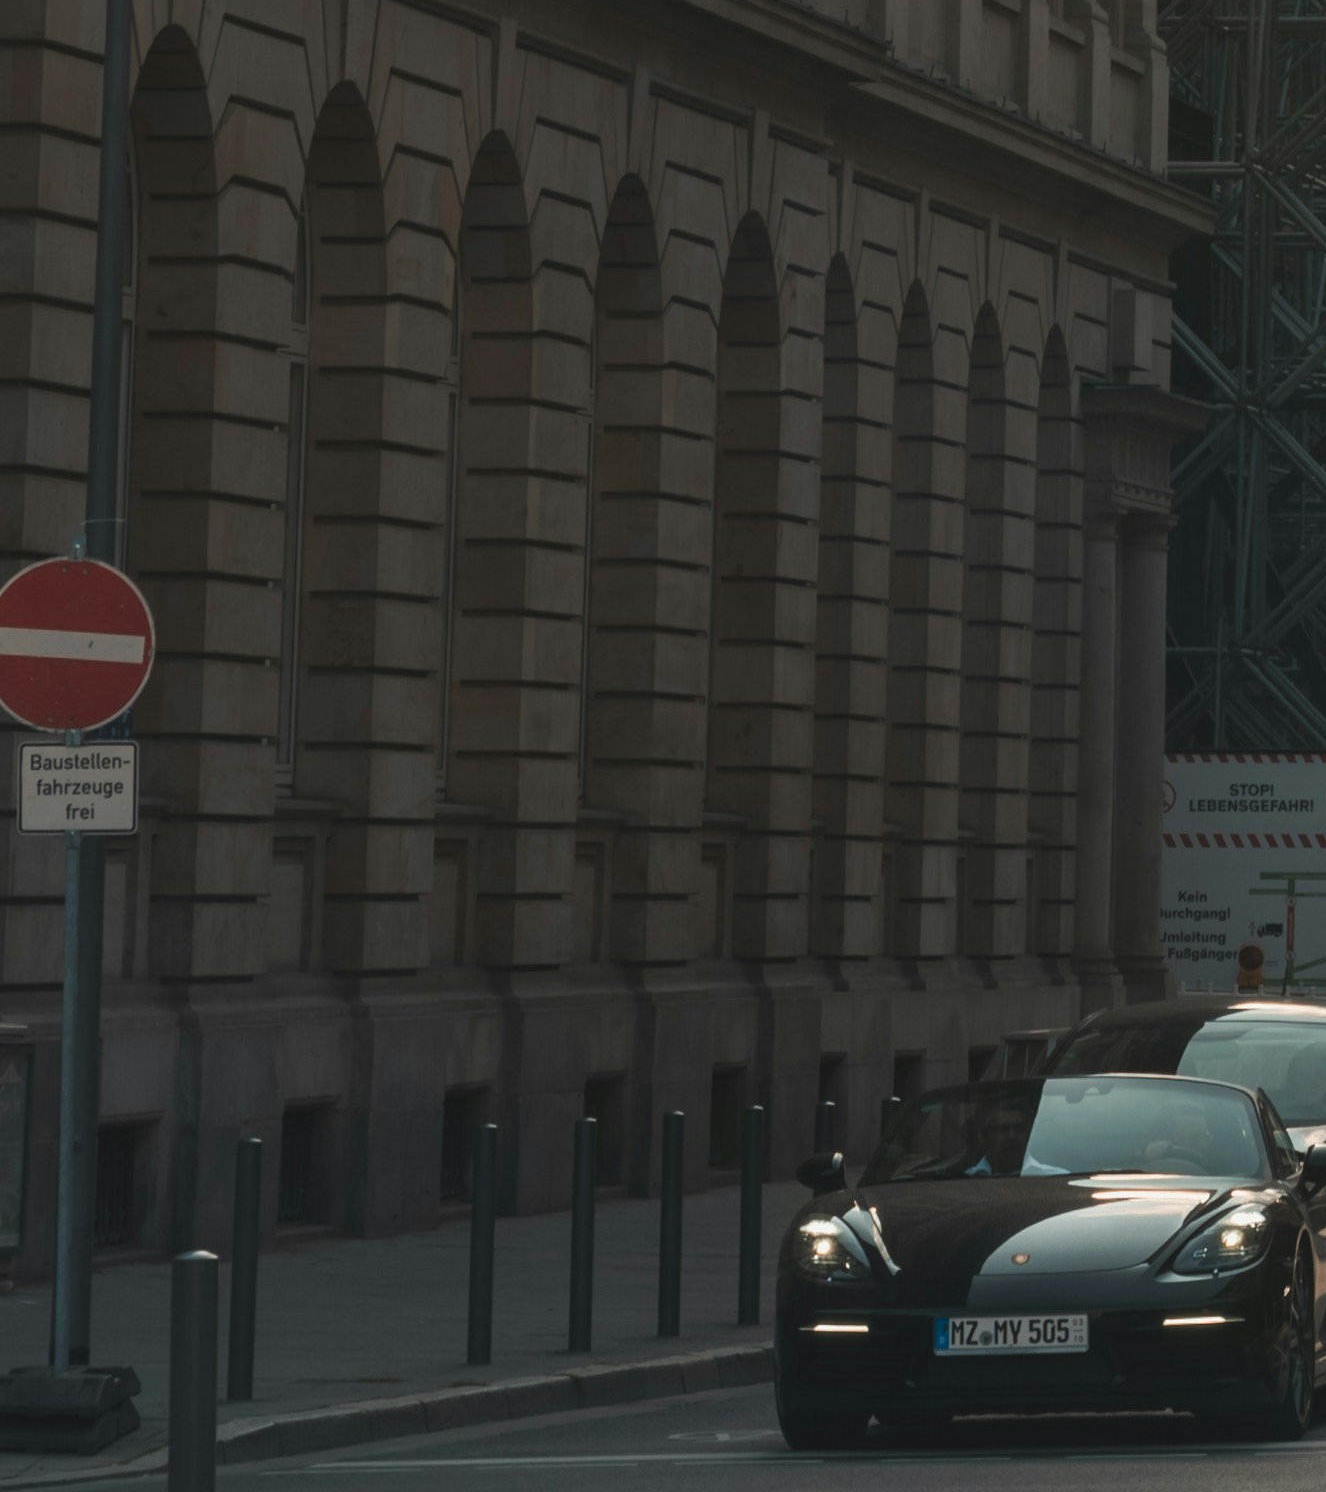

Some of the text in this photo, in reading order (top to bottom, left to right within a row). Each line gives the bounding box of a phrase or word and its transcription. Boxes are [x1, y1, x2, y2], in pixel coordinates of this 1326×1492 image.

[30, 753, 131, 771] Baustellen-
[36, 778, 125, 799] fahrzeuge
[1229, 784, 1275, 797] STOP!
[66, 803, 95, 820] frei
[1188, 799, 1315, 813] LEBENSGEFAHR!
[1177, 891, 1208, 903] Kein
[1167, 947, 1239, 962] Fußgänger
[951, 1318, 1070, 1346] MZ MY 505
